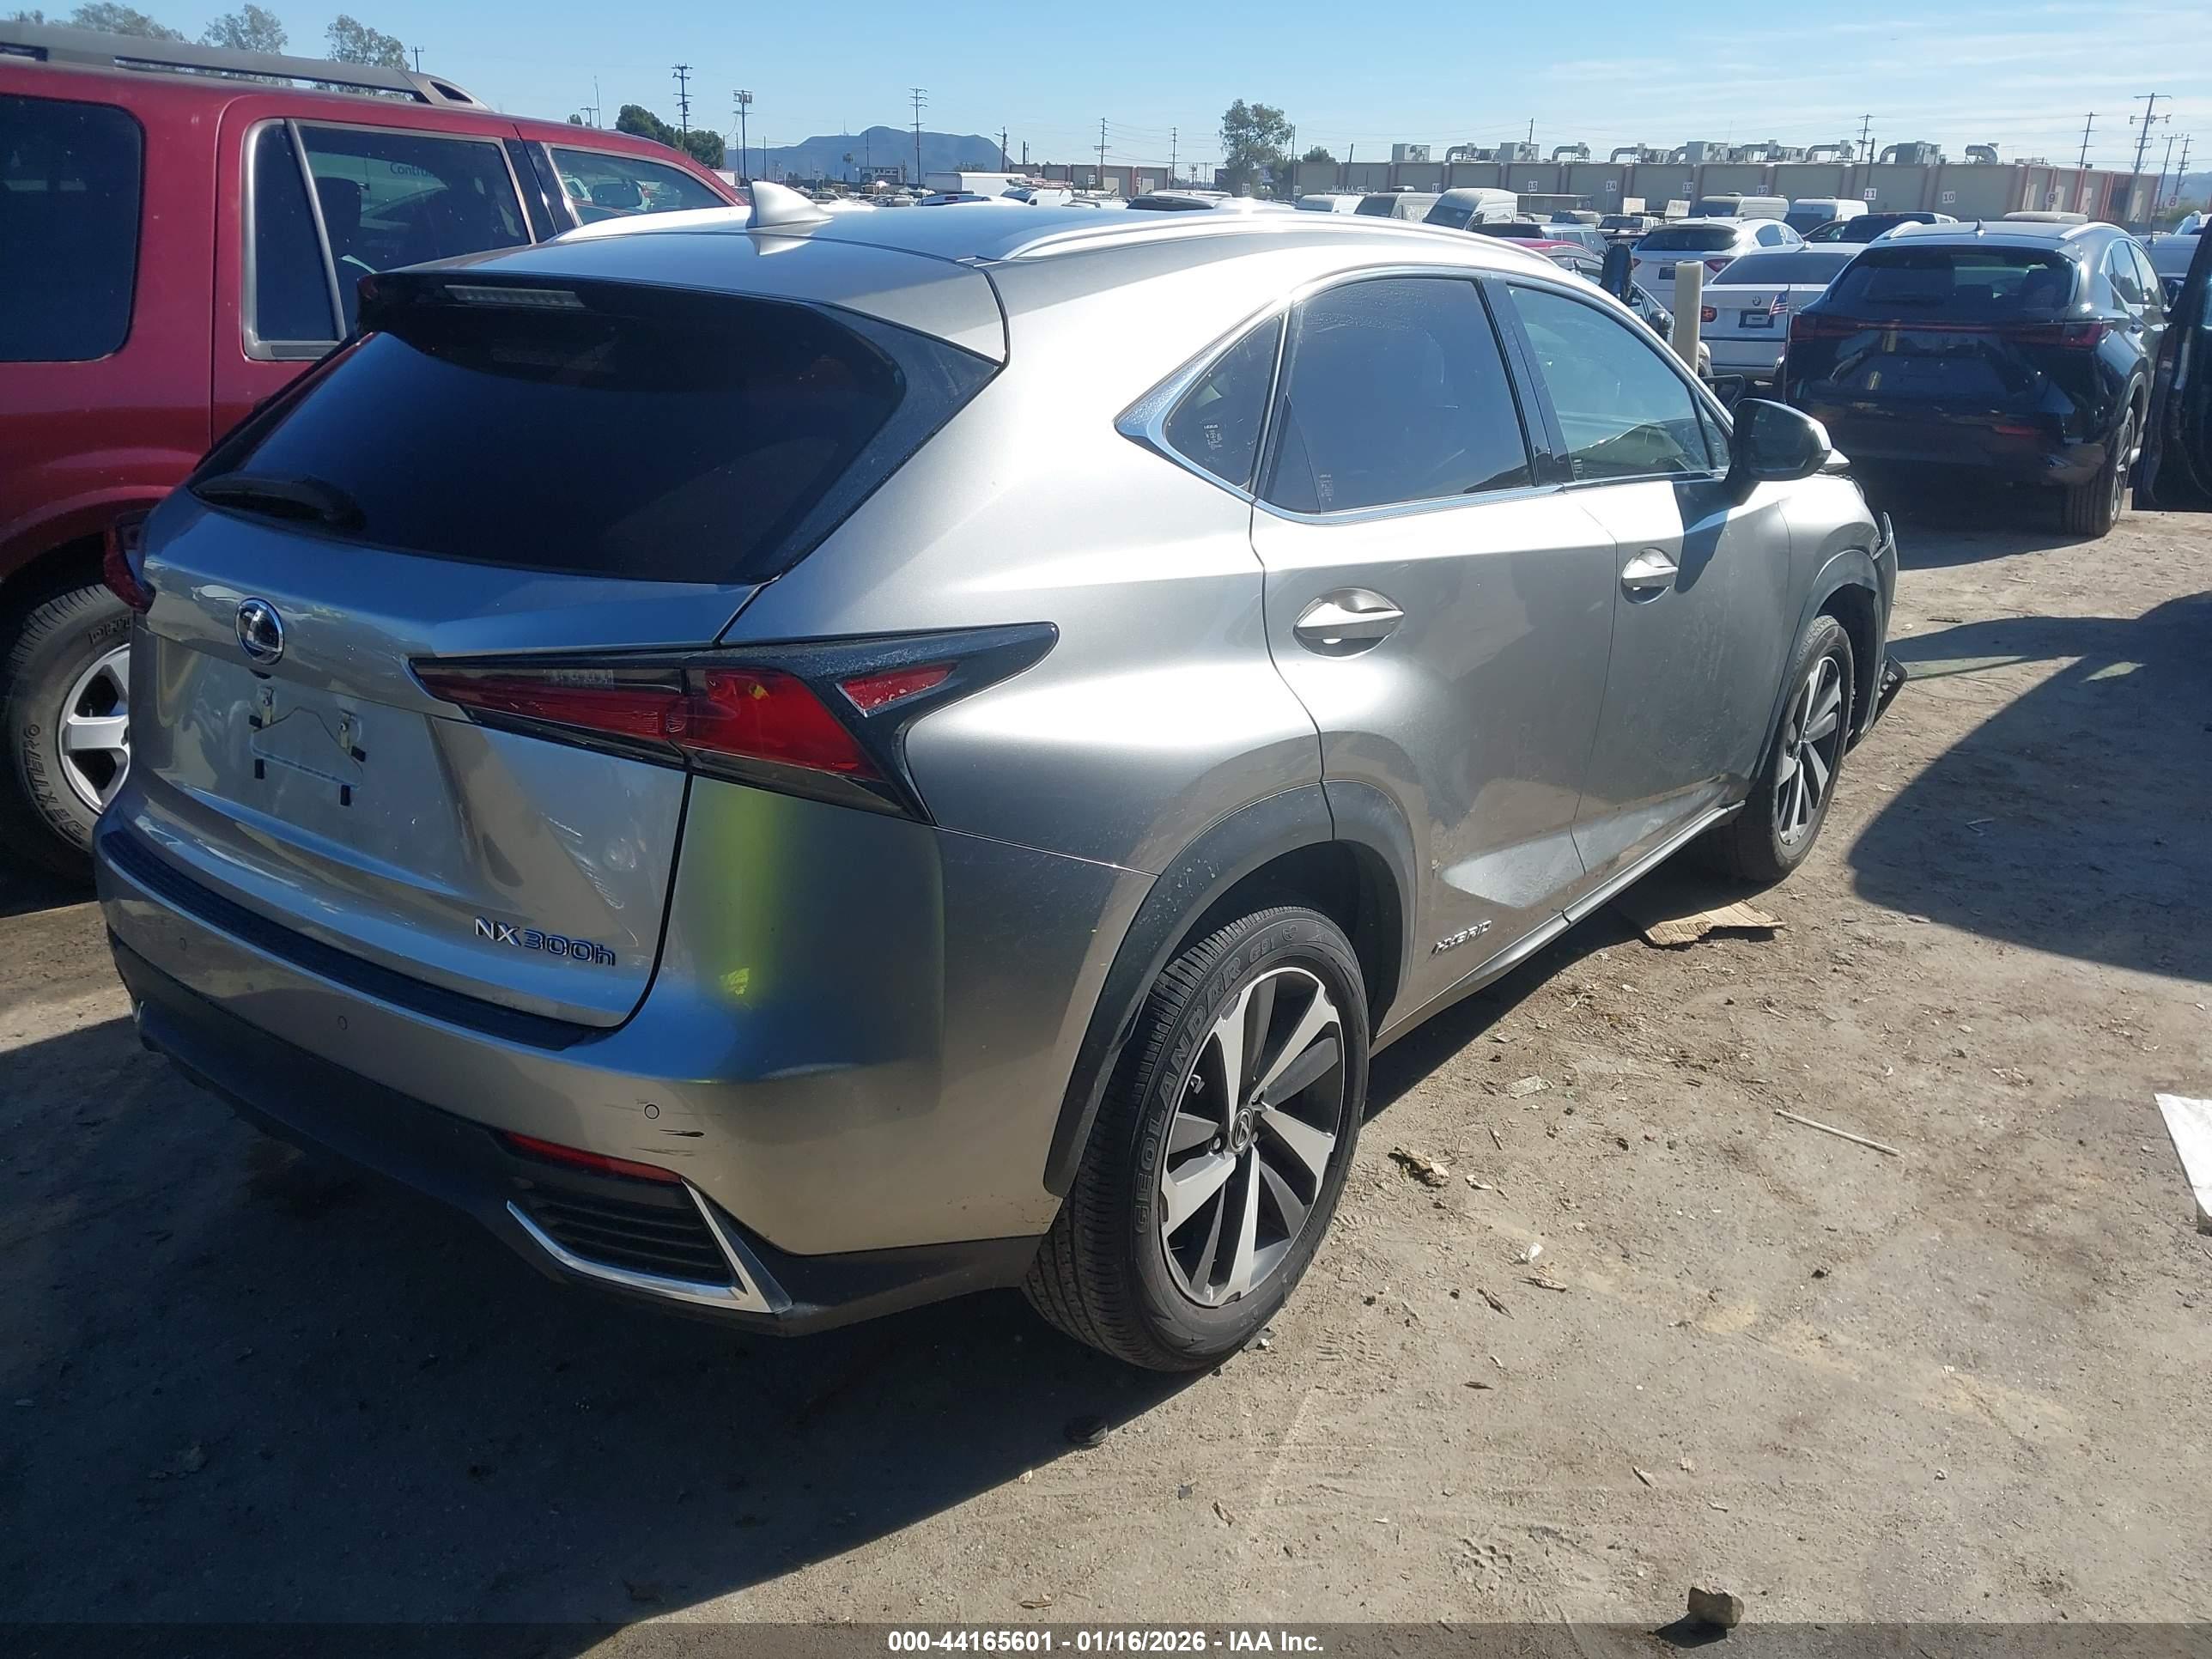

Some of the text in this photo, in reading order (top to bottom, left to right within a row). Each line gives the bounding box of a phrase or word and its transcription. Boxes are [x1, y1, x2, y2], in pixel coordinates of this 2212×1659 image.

[1865, 190, 1875, 198] 11
[1943, 193, 1954, 202] 10
[475, 916, 616, 967] NX 300h
[1134, 955, 1242, 1234] GEOLANDAR
